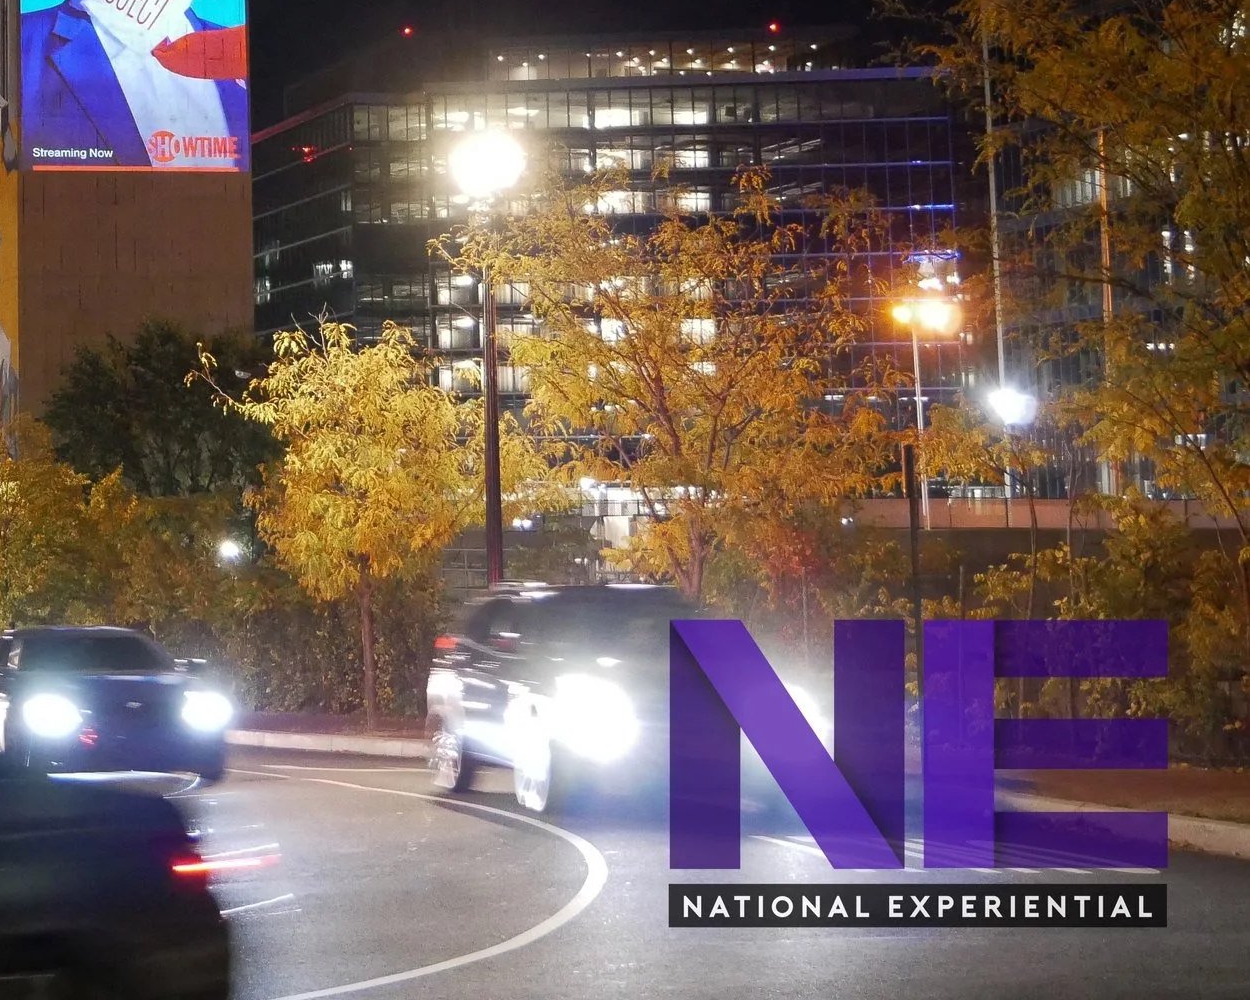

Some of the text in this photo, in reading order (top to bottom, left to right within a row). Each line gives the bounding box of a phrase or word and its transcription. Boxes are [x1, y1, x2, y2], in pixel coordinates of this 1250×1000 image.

[32, 147, 114, 160] Streaming Now
[148, 130, 240, 163] SHOWTIME
